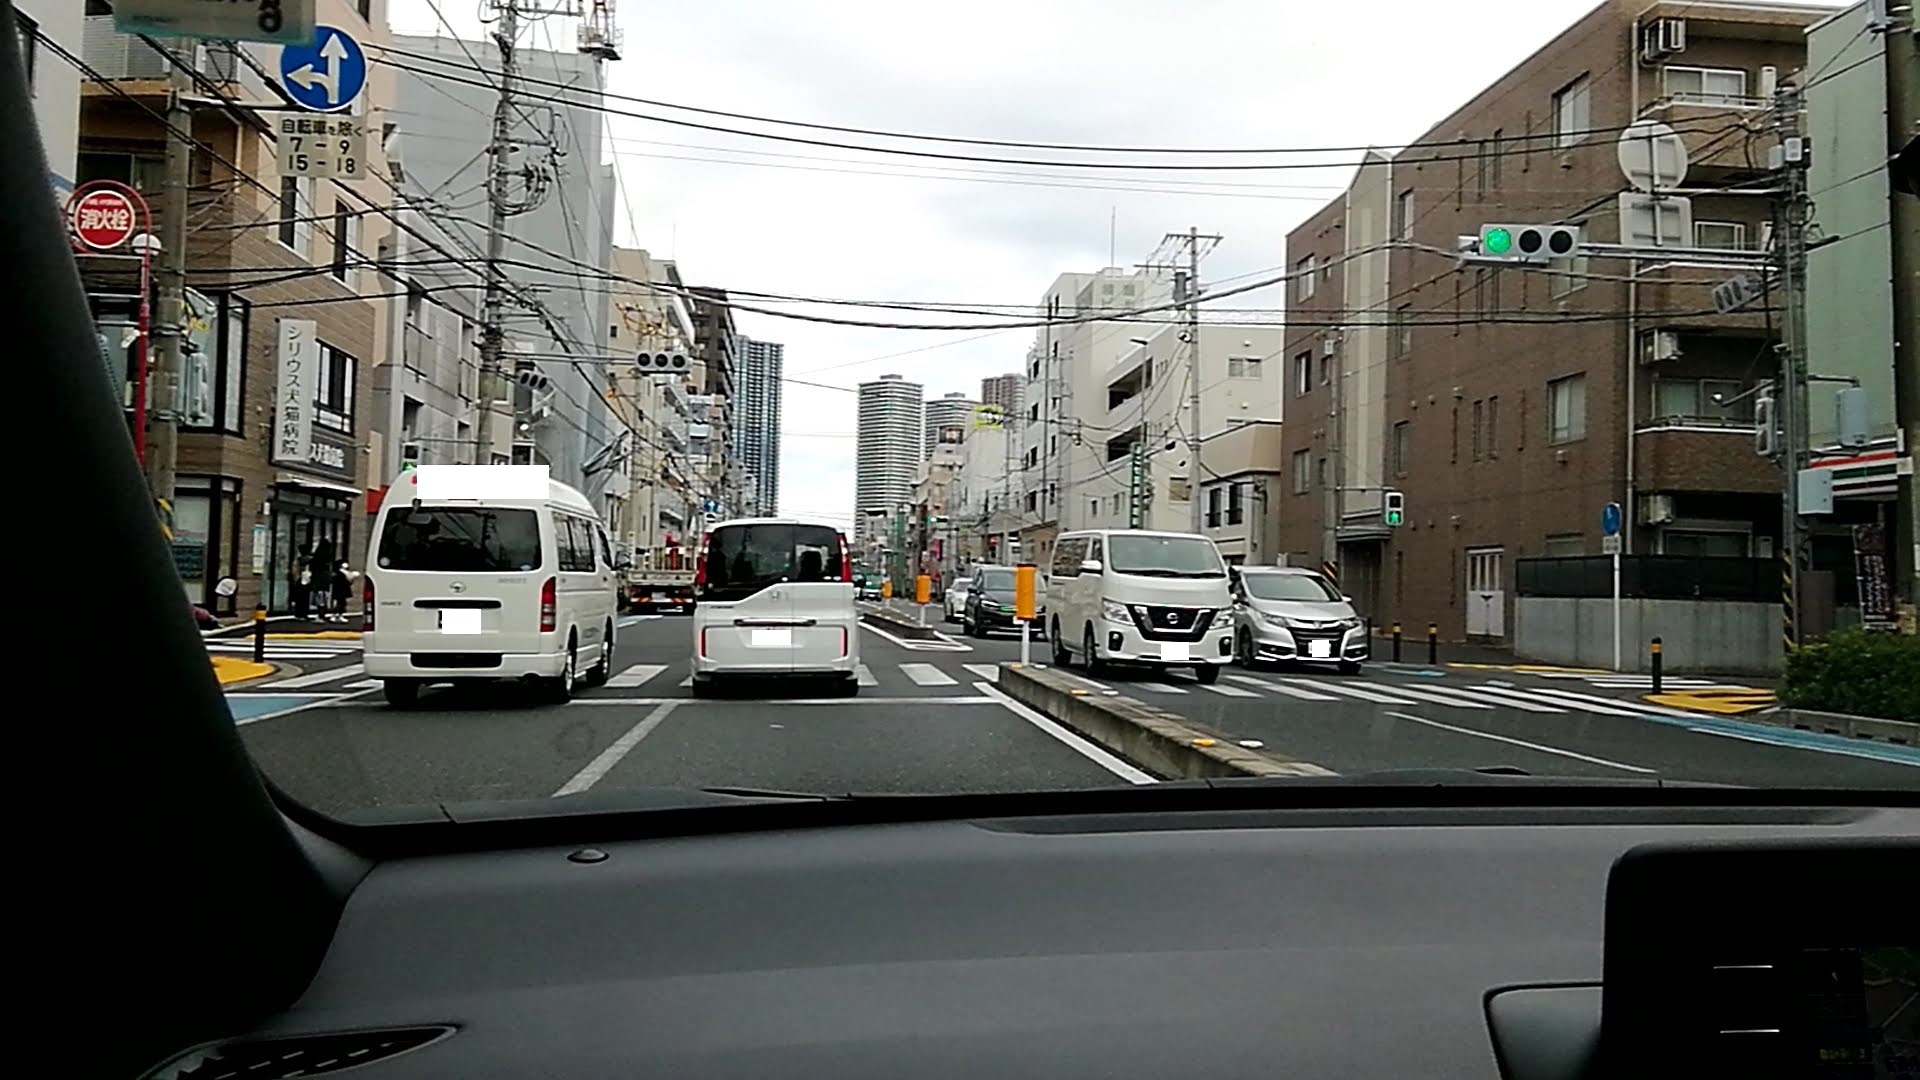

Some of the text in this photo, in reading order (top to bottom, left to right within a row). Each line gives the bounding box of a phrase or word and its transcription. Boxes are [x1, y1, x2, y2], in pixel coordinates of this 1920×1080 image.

[282, 119, 362, 137] 自転車を除く
[80, 208, 130, 231] 消火栓
[281, 326, 302, 456] シリウス犬猫病院
